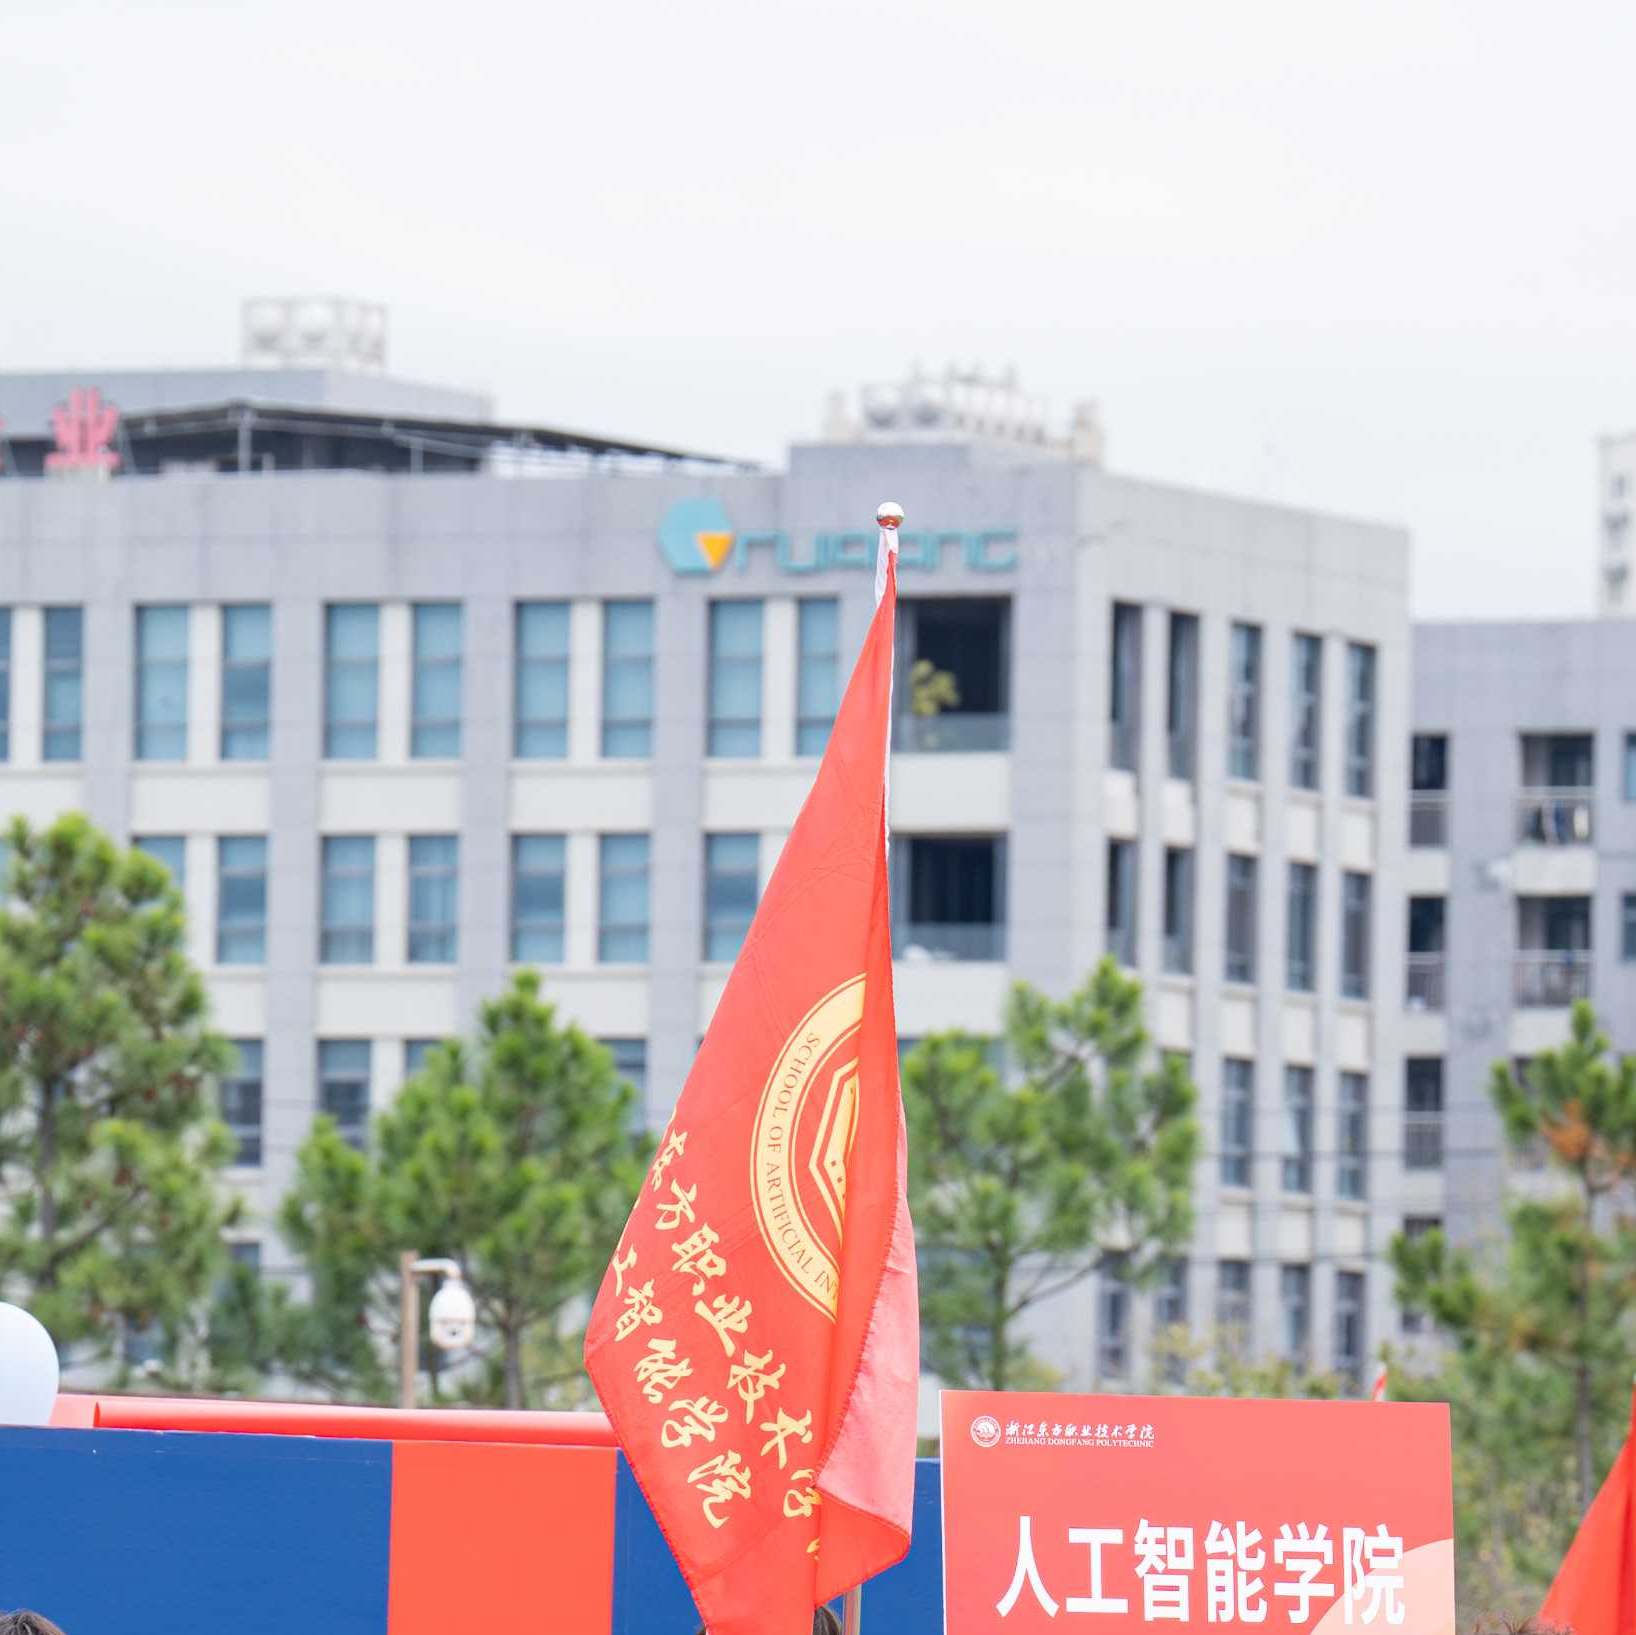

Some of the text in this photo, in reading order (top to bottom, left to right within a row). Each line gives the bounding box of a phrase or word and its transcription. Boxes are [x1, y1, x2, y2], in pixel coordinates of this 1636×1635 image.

[771, 1031, 821, 1119] SCHOOL
[767, 1125, 783, 1154] OF
[765, 1161, 811, 1275] ARTIFICIAL
[1004, 1421, 1155, 1440] 浙江东方职业技术学院
[1004, 1437, 1155, 1449] ZHEJIANG DONGFANG POLYTECHNIC
[995, 1515, 1406, 1626] 人工智能学院
